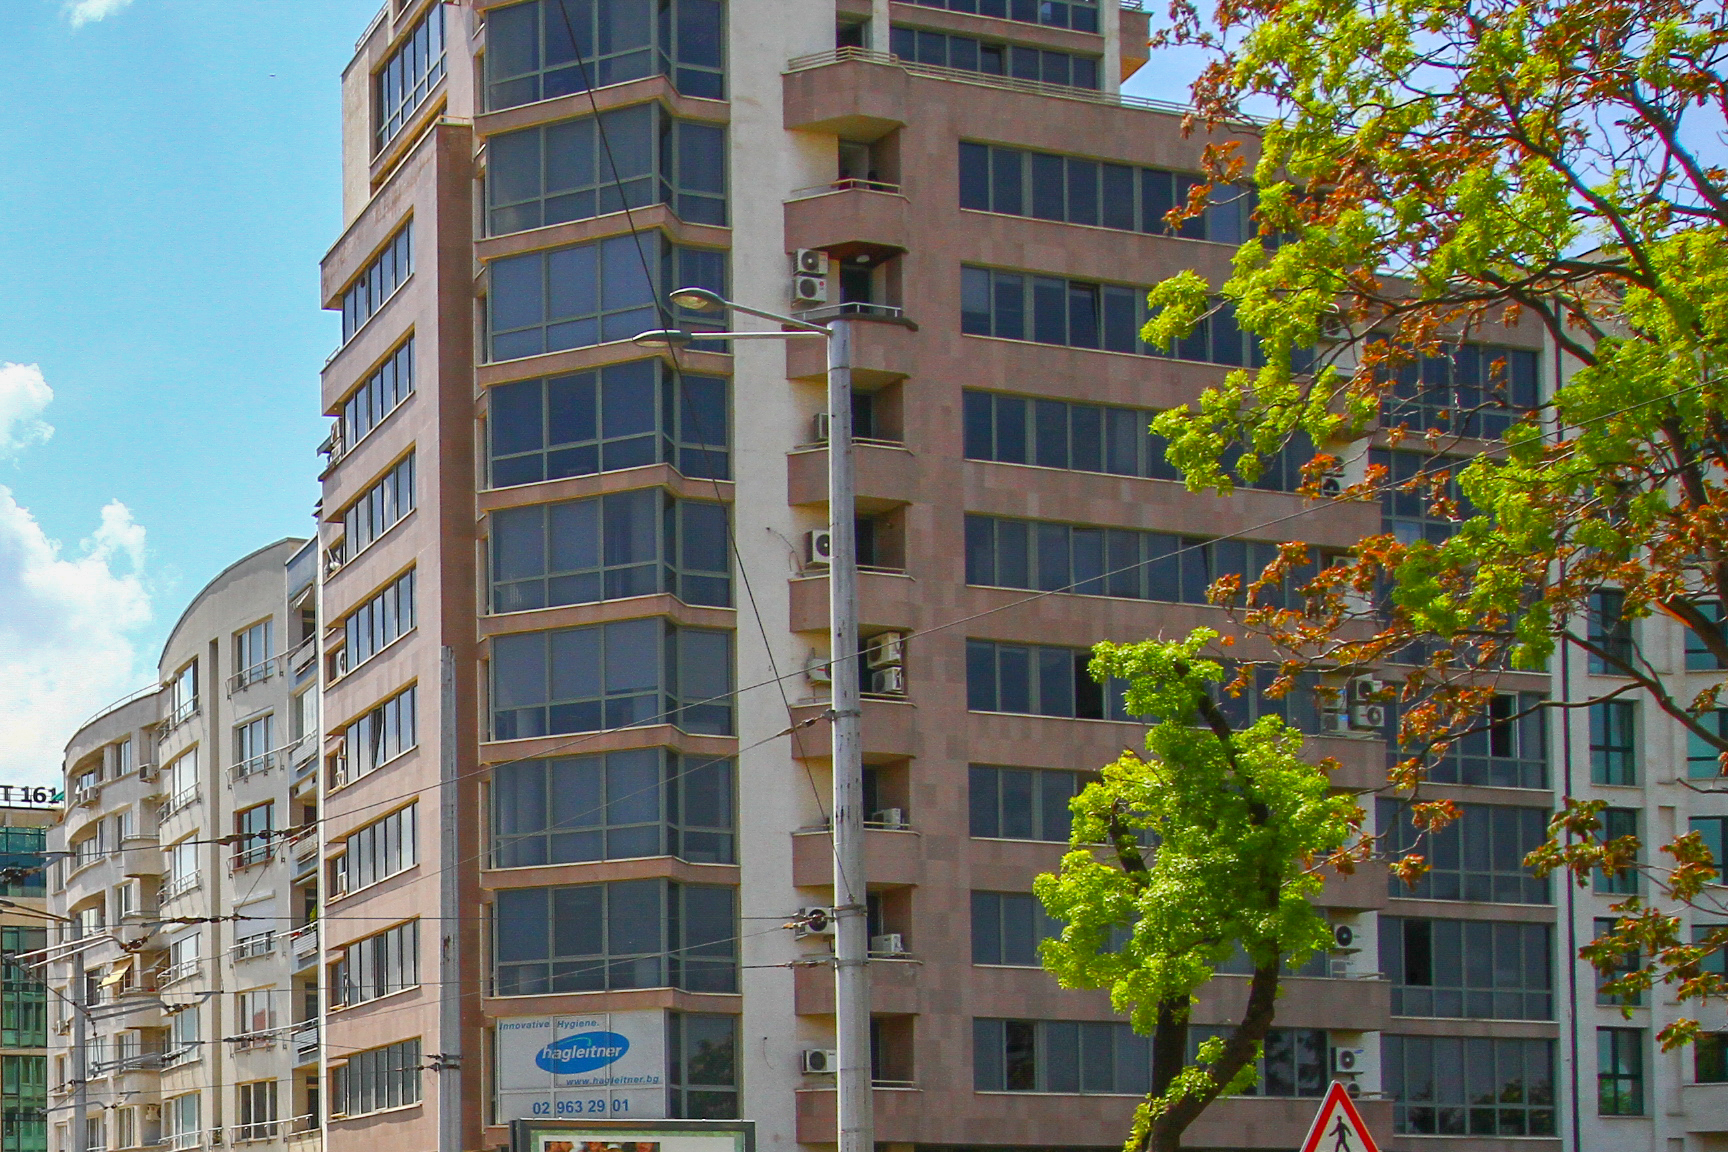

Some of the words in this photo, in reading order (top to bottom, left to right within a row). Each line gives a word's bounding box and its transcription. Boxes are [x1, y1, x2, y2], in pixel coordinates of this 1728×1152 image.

[21, 786, 59, 803] 161
[499, 1020, 550, 1031] Innovative
[557, 1019, 600, 1030] Hygiene.
[542, 1043, 623, 1063] hagleitner
[566, 1074, 660, 1086] www.hagleitner.bg
[532, 1102, 550, 1115] 02
[557, 1101, 583, 1114] 963
[588, 1100, 606, 1113] 29
[612, 1099, 629, 1112] 01
